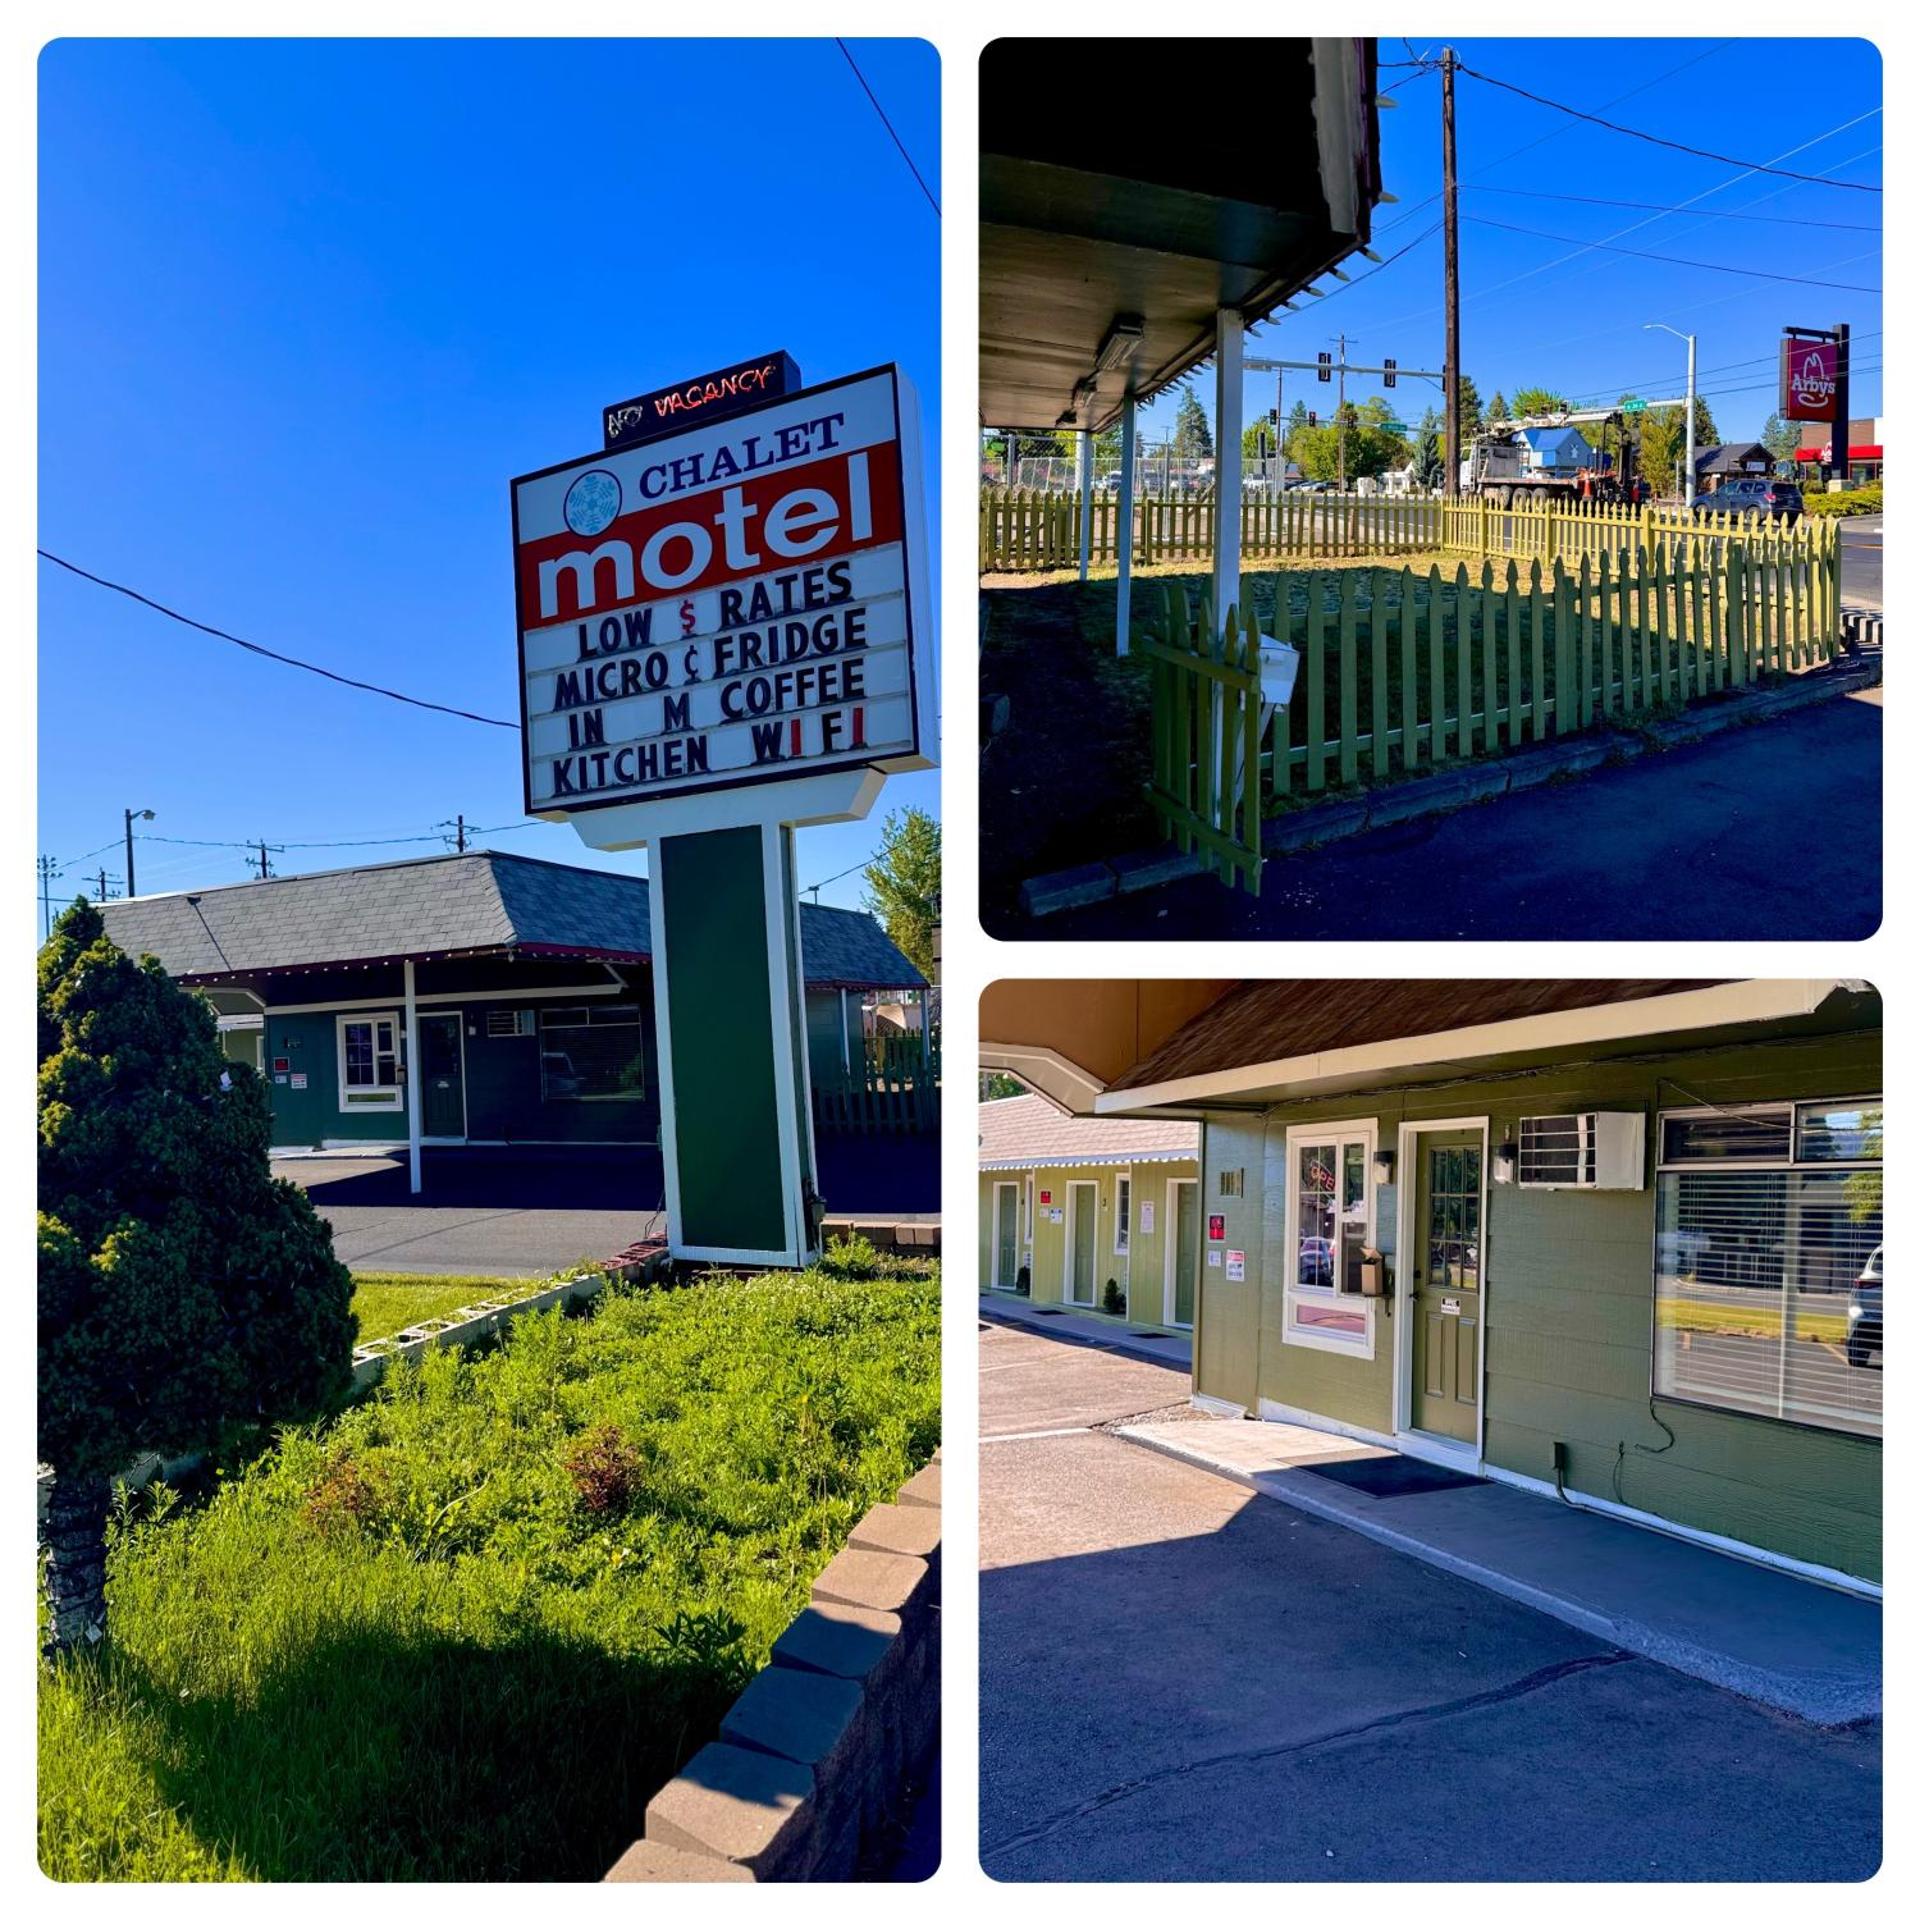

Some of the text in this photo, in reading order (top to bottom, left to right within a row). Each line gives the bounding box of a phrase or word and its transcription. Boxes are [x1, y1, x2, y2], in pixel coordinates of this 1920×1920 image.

[654, 364, 776, 416] VACANCY
[1792, 374, 1836, 397] Arby's
[639, 413, 845, 498] CHALET
[538, 452, 873, 618] motel
[578, 561, 852, 660] LOW $ RATES
[554, 647, 668, 710] MICRO
[714, 608, 867, 675] FRIDGE
[570, 659, 864, 748] IN M COFFEE
[553, 735, 708, 794] KITCHEN
[1311, 1165, 1336, 1190] OPE
